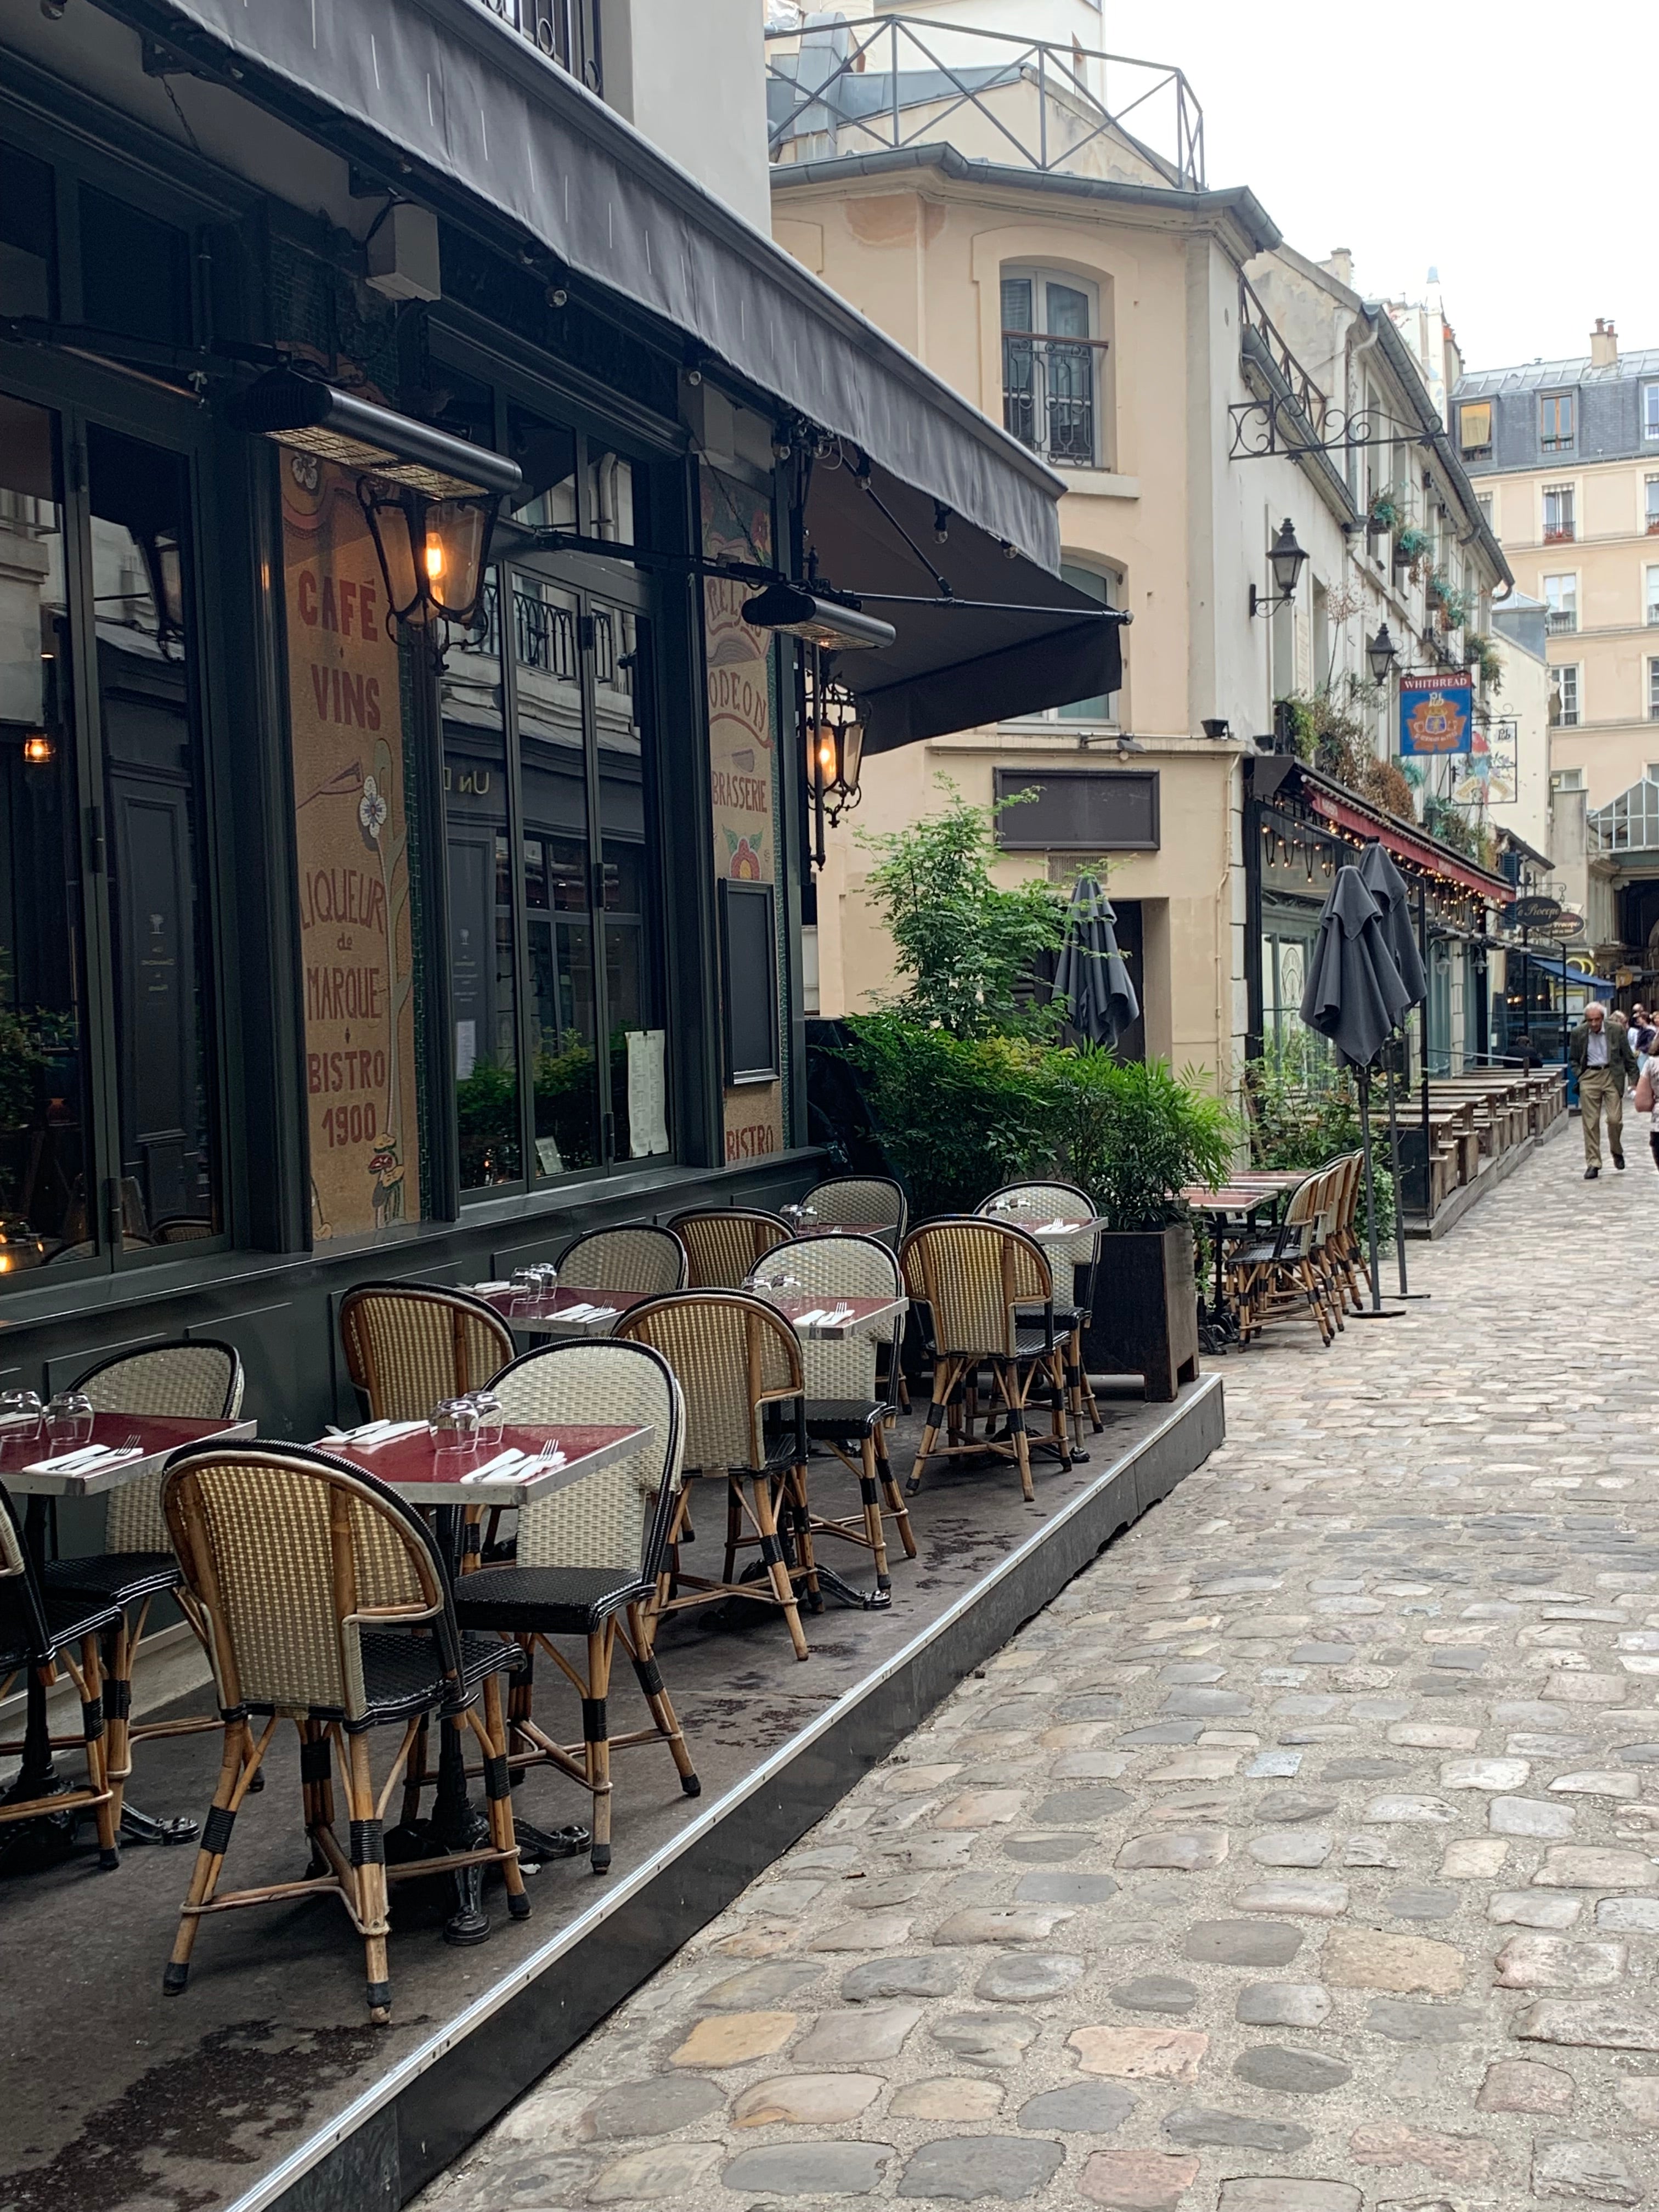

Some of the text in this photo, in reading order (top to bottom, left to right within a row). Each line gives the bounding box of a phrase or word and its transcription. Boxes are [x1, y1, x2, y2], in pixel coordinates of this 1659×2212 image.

[298, 570, 379, 642] CAFÉ
[311, 663, 381, 731] VINS
[709, 669, 767, 733] ODEON
[1404, 678, 1468, 689] WHITBREAD
[712, 771, 768, 813] BRASSERIE
[300, 868, 385, 935] LIQUEUR
[337, 933, 352, 951] de
[307, 967, 382, 1020] MARQUE
[307, 1049, 385, 1094] BISTRO
[321, 1102, 376, 1148] 1900
[726, 1124, 774, 1161] BISTRO
